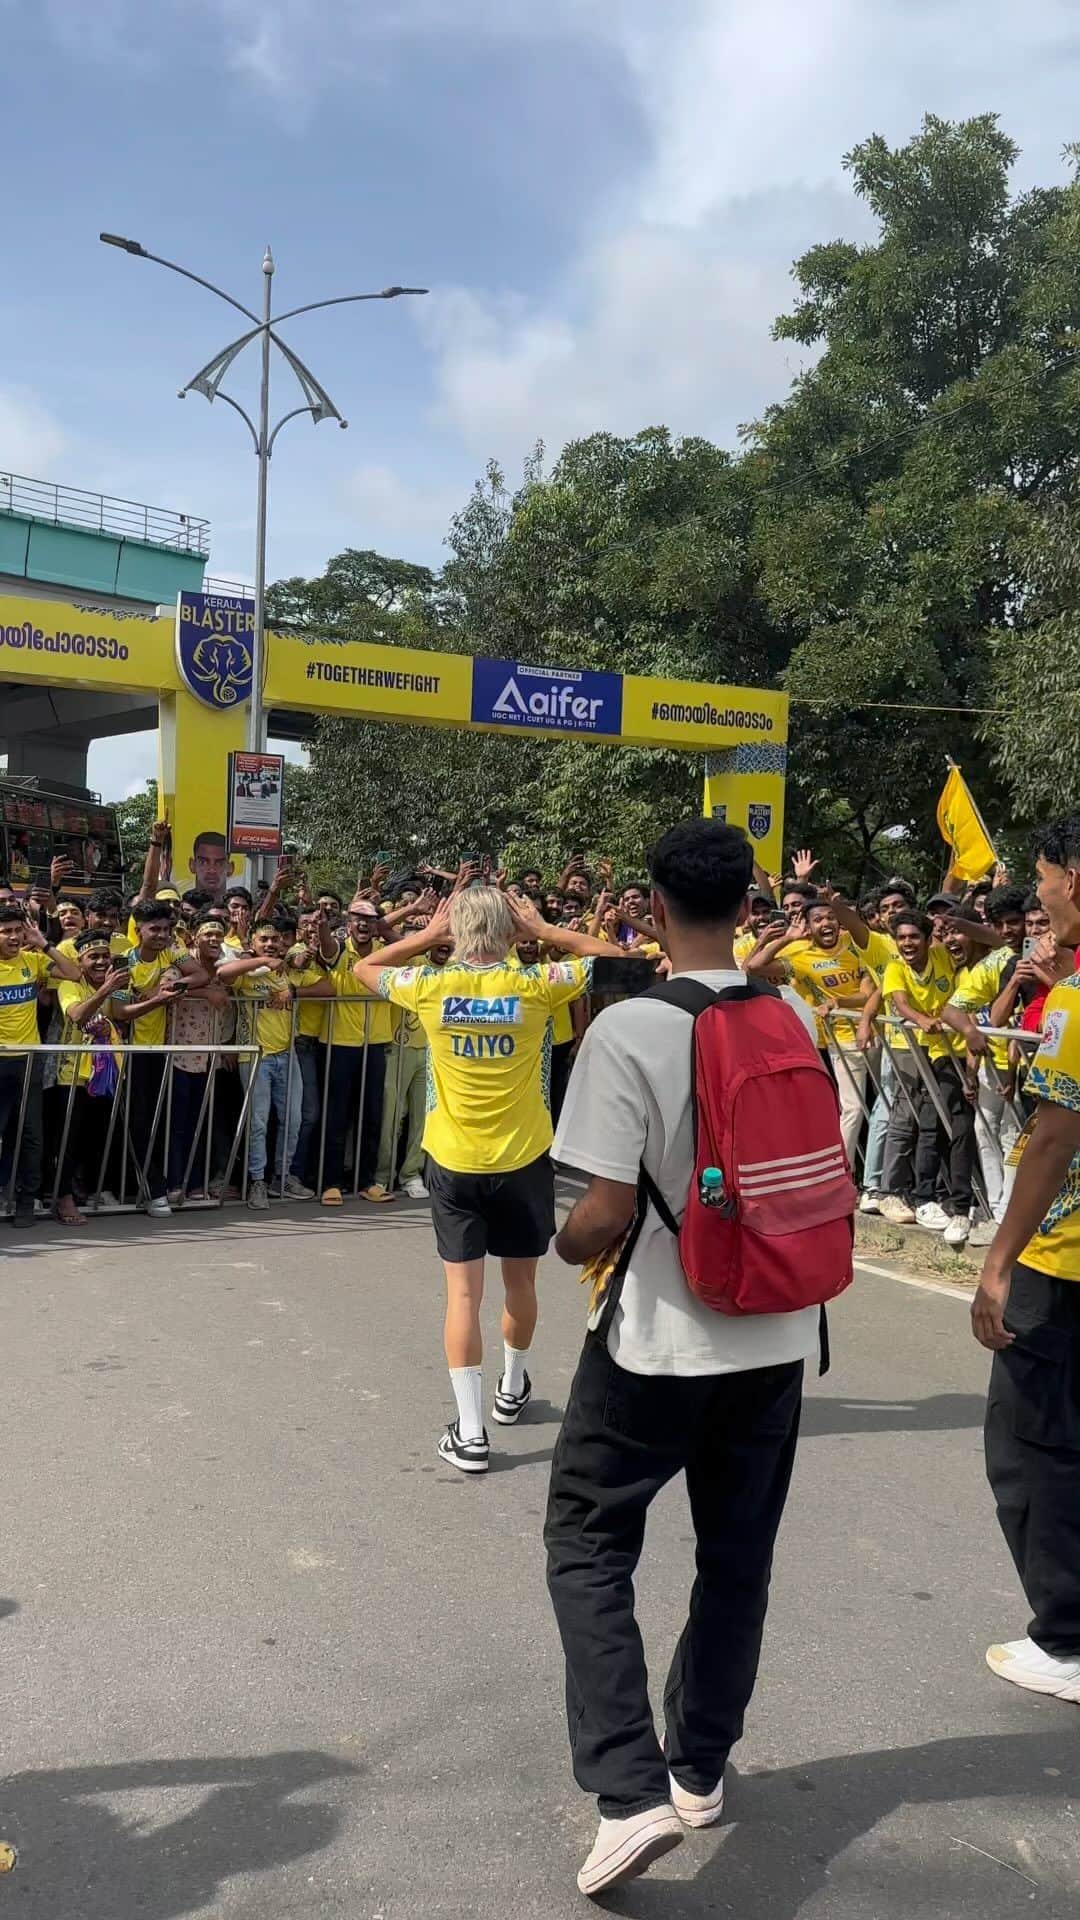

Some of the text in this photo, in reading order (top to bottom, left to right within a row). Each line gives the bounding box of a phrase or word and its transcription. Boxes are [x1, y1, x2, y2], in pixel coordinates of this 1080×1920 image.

[203, 596, 242, 610] KERALA
[181, 604, 256, 633] BLASTER
[306, 661, 441, 694] #TOGETHERWEFIGHT
[519, 667, 581, 680] OFFICIAL PARTNER
[443, 996, 520, 1015] 1XBAT
[451, 1034, 515, 1058] TAIYO
